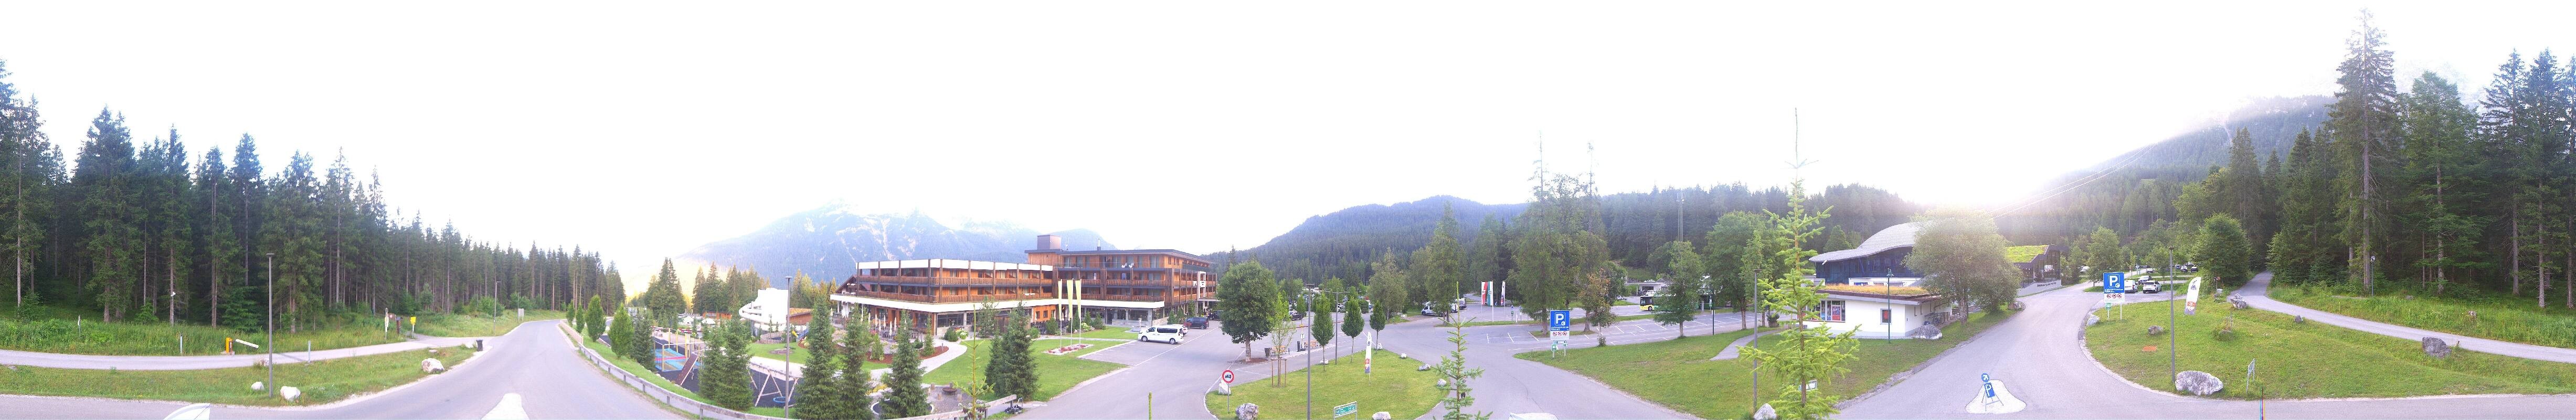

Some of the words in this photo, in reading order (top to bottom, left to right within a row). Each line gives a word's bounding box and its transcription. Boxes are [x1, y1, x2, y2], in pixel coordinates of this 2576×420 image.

[2109, 275, 2118, 286] P
[1555, 313, 1564, 324] P
[1985, 384, 1991, 397] P
